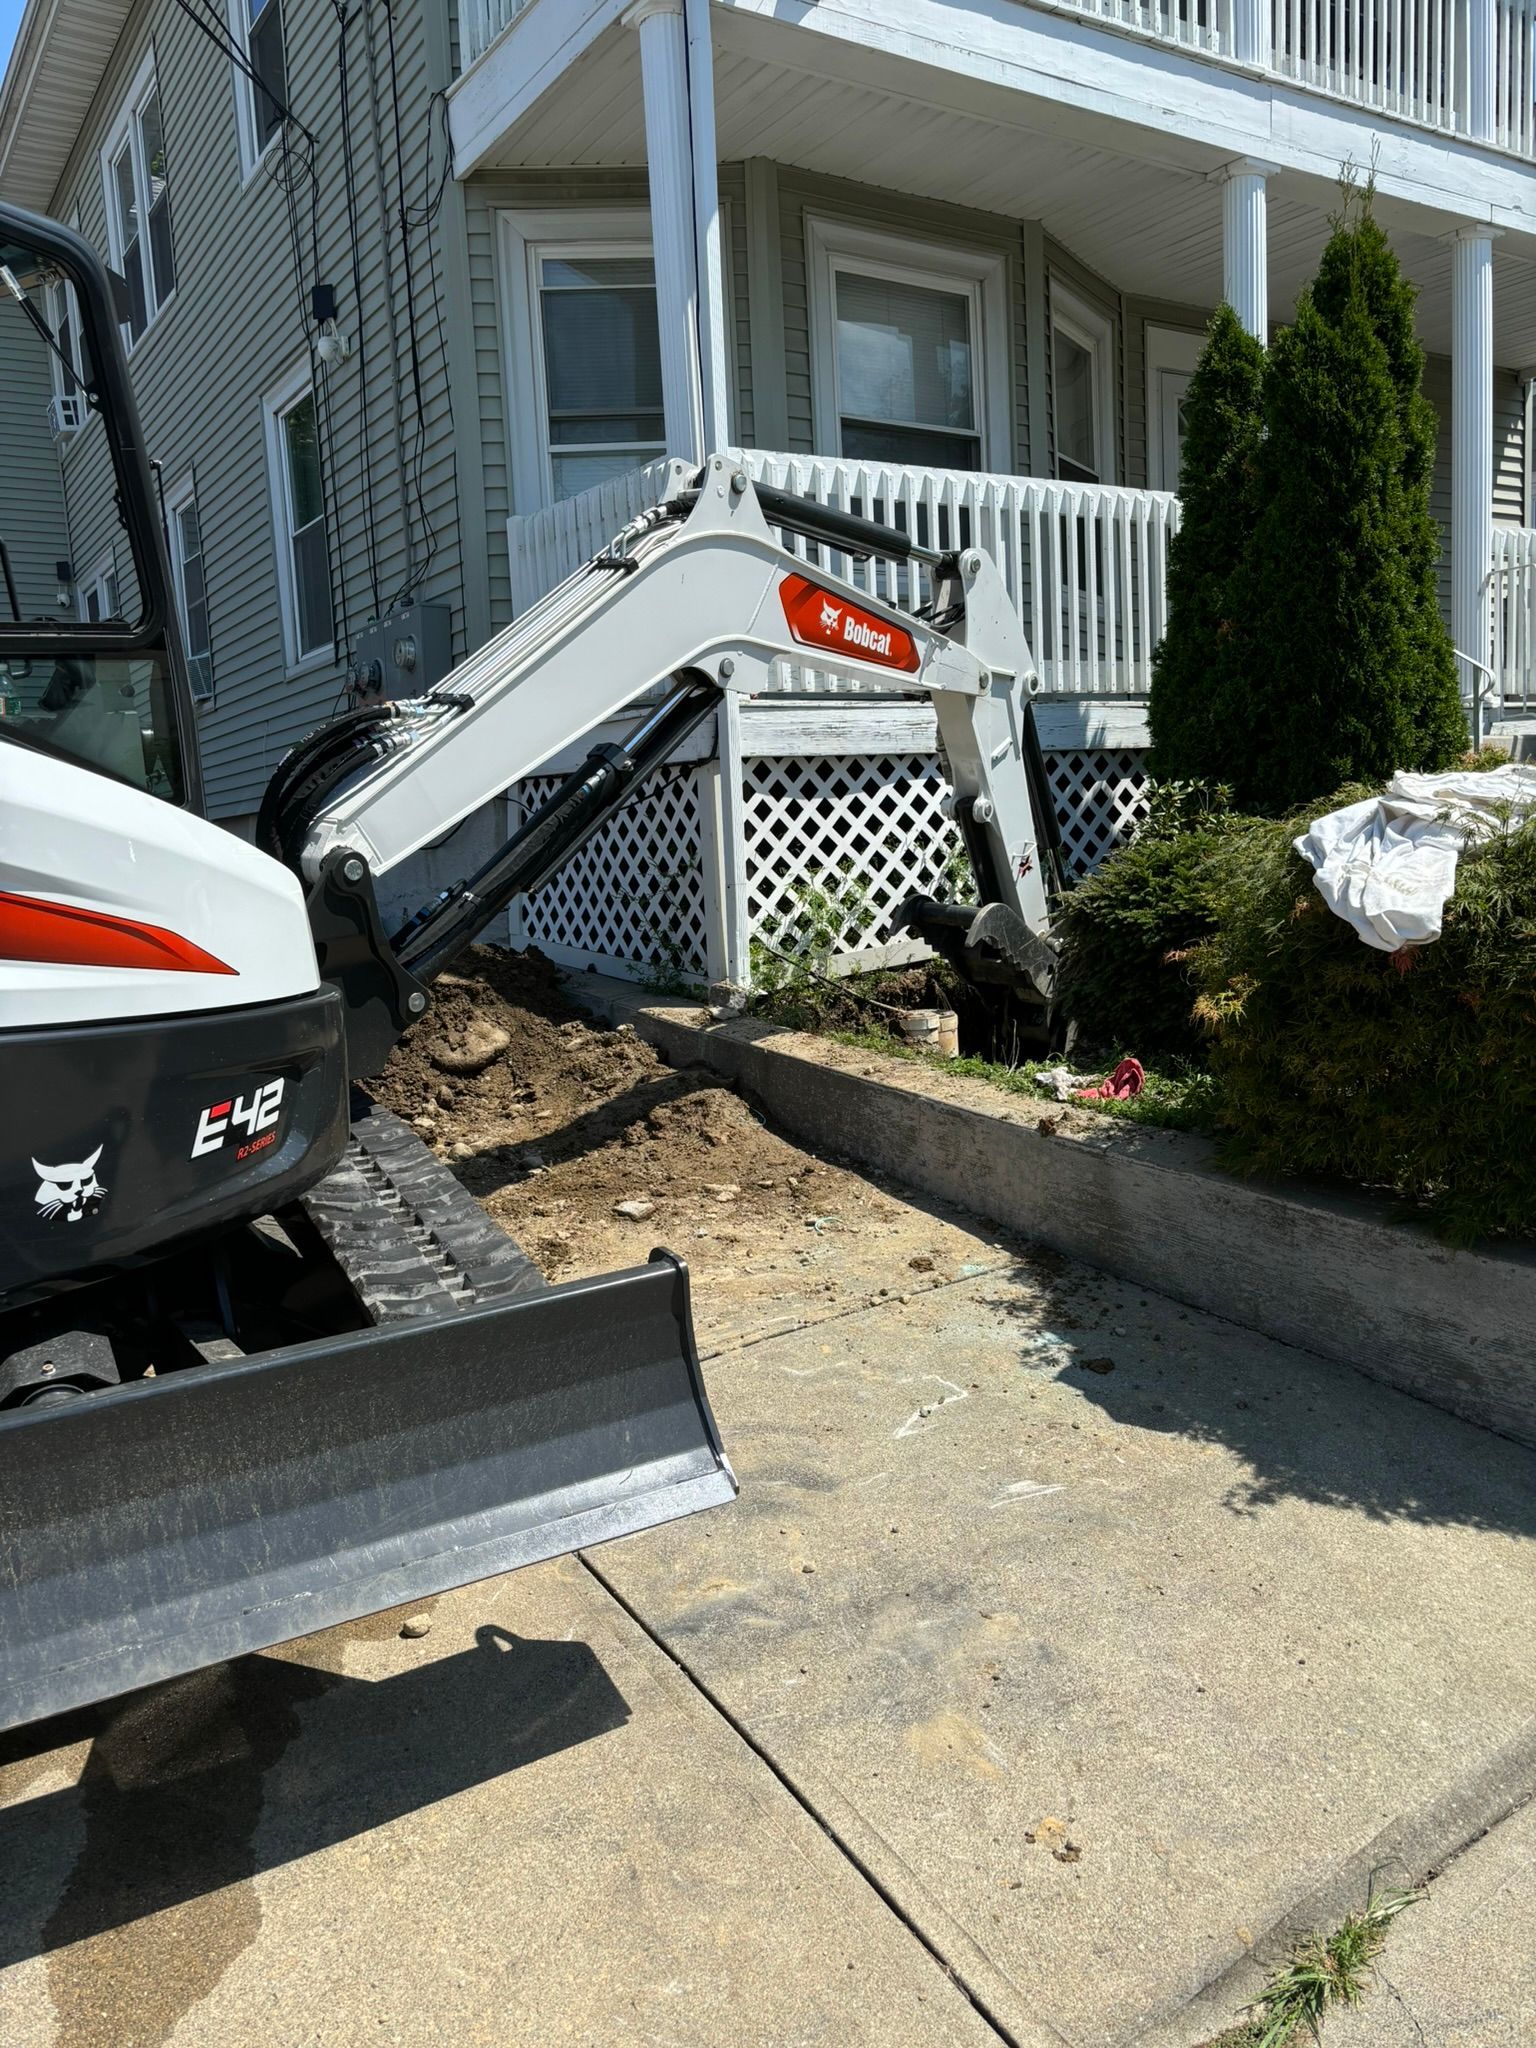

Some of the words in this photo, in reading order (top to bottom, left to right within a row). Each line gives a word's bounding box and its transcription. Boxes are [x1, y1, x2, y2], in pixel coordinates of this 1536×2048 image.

[843, 615, 891, 656] Bobcat
[190, 1077, 285, 1159] E42
[236, 1131, 277, 1160] R2-SERIES
